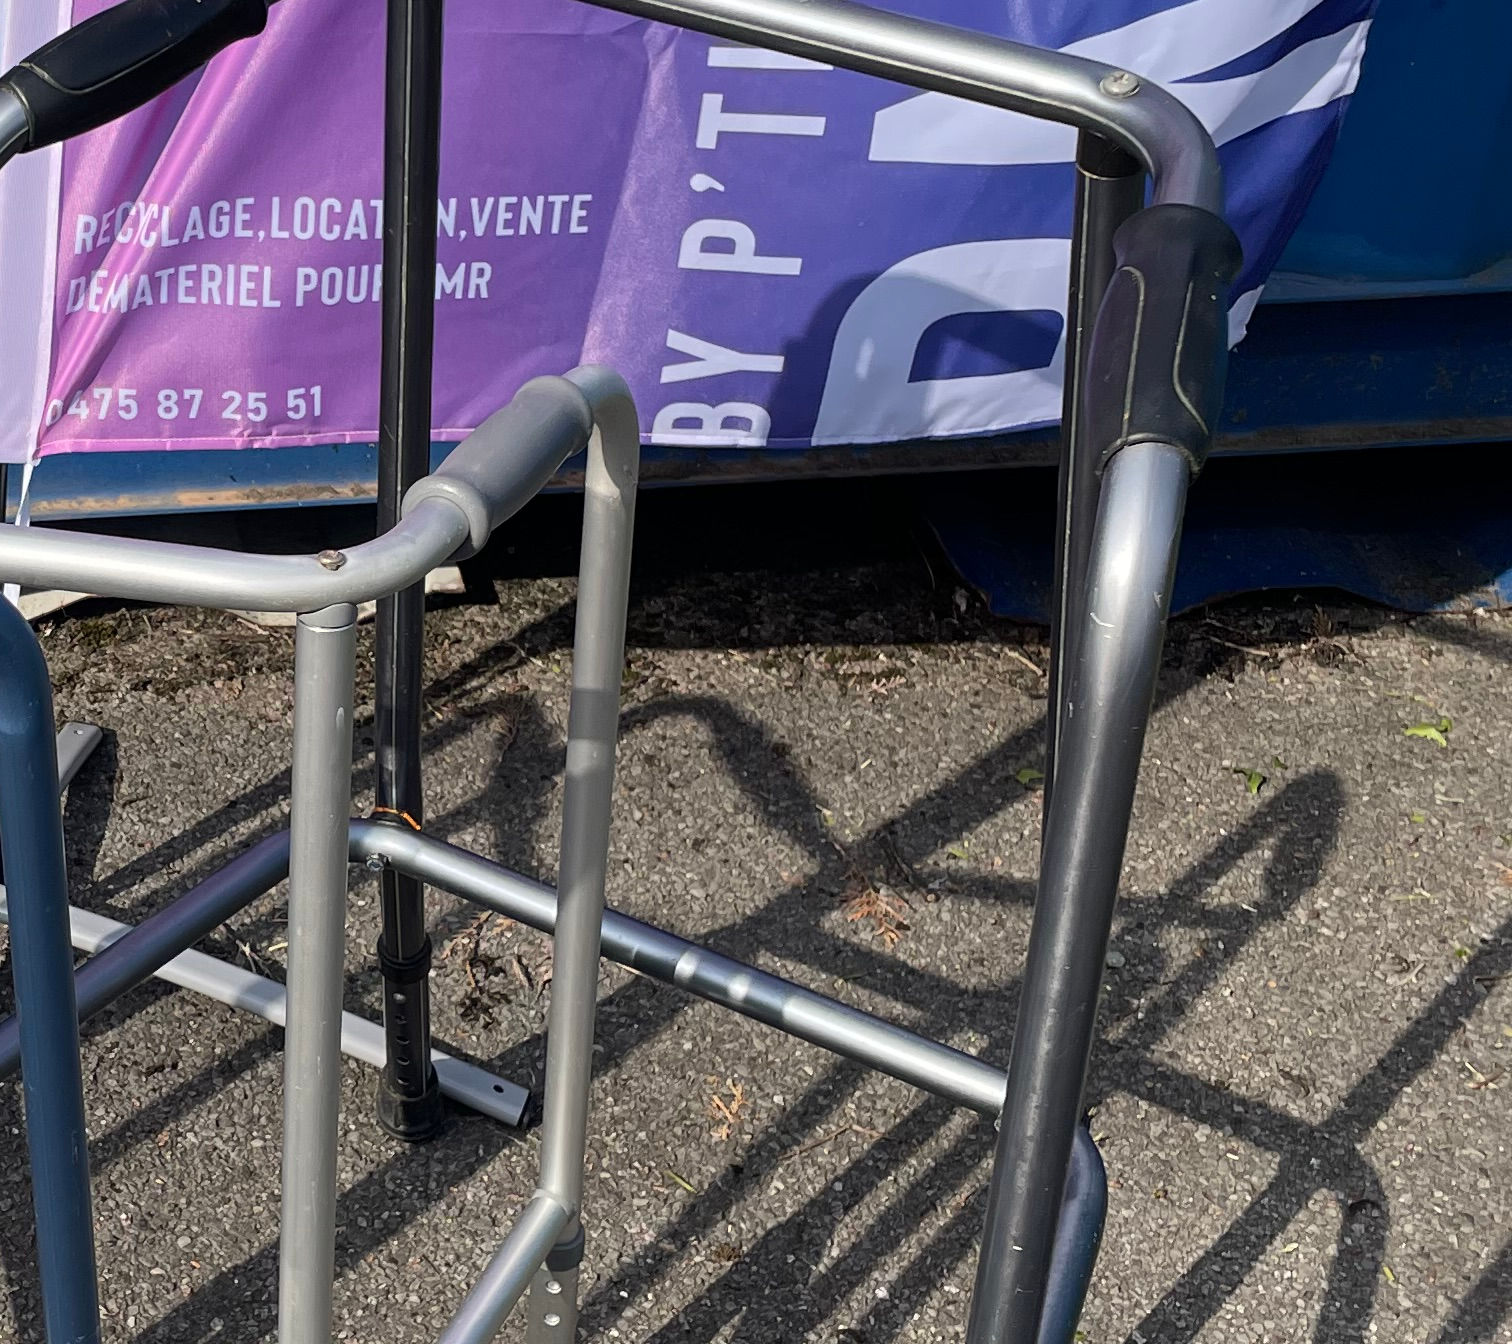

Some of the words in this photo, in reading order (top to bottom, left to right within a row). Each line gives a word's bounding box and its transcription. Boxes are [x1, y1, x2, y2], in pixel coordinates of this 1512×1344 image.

[157, 388, 204, 421] 87
[221, 390, 268, 423] 25
[286, 385, 323, 420] 51
[651, 328, 785, 446] BY
